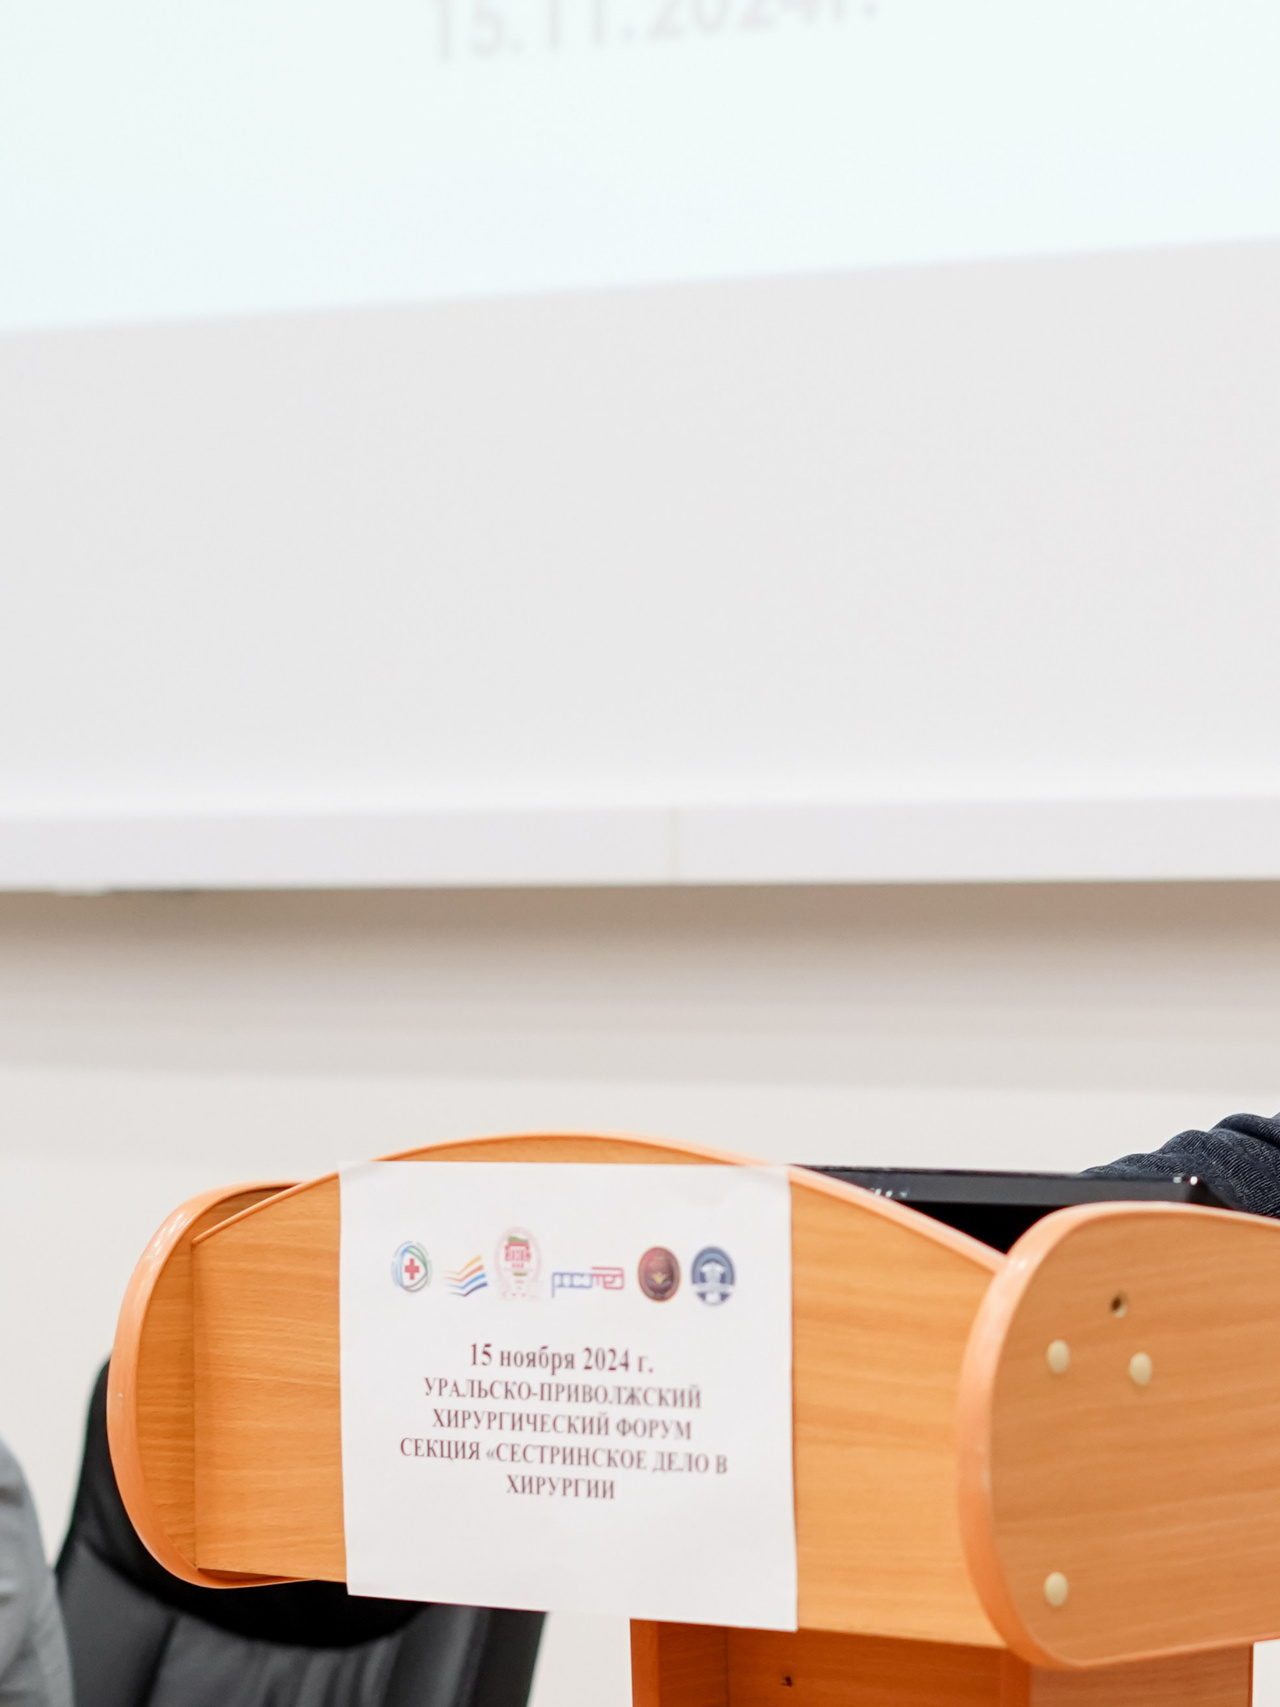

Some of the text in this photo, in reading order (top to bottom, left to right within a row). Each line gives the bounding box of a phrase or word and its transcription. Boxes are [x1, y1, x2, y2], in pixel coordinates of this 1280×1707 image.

[470, 1343, 654, 1376] 15 ноября 2024 г.
[424, 1377, 702, 1409] УРАЛЬСКО-ПРИВОЛЖСКИЙ
[432, 1408, 692, 1441] ХИРУРГИЧЕСКИЙ ФОРУМ
[400, 1437, 728, 1474] СЕКЦИЯ «СЕСТРИНСКОЕ ДЕЛО В
[506, 1474, 615, 1500] ХИРУРГИИ
